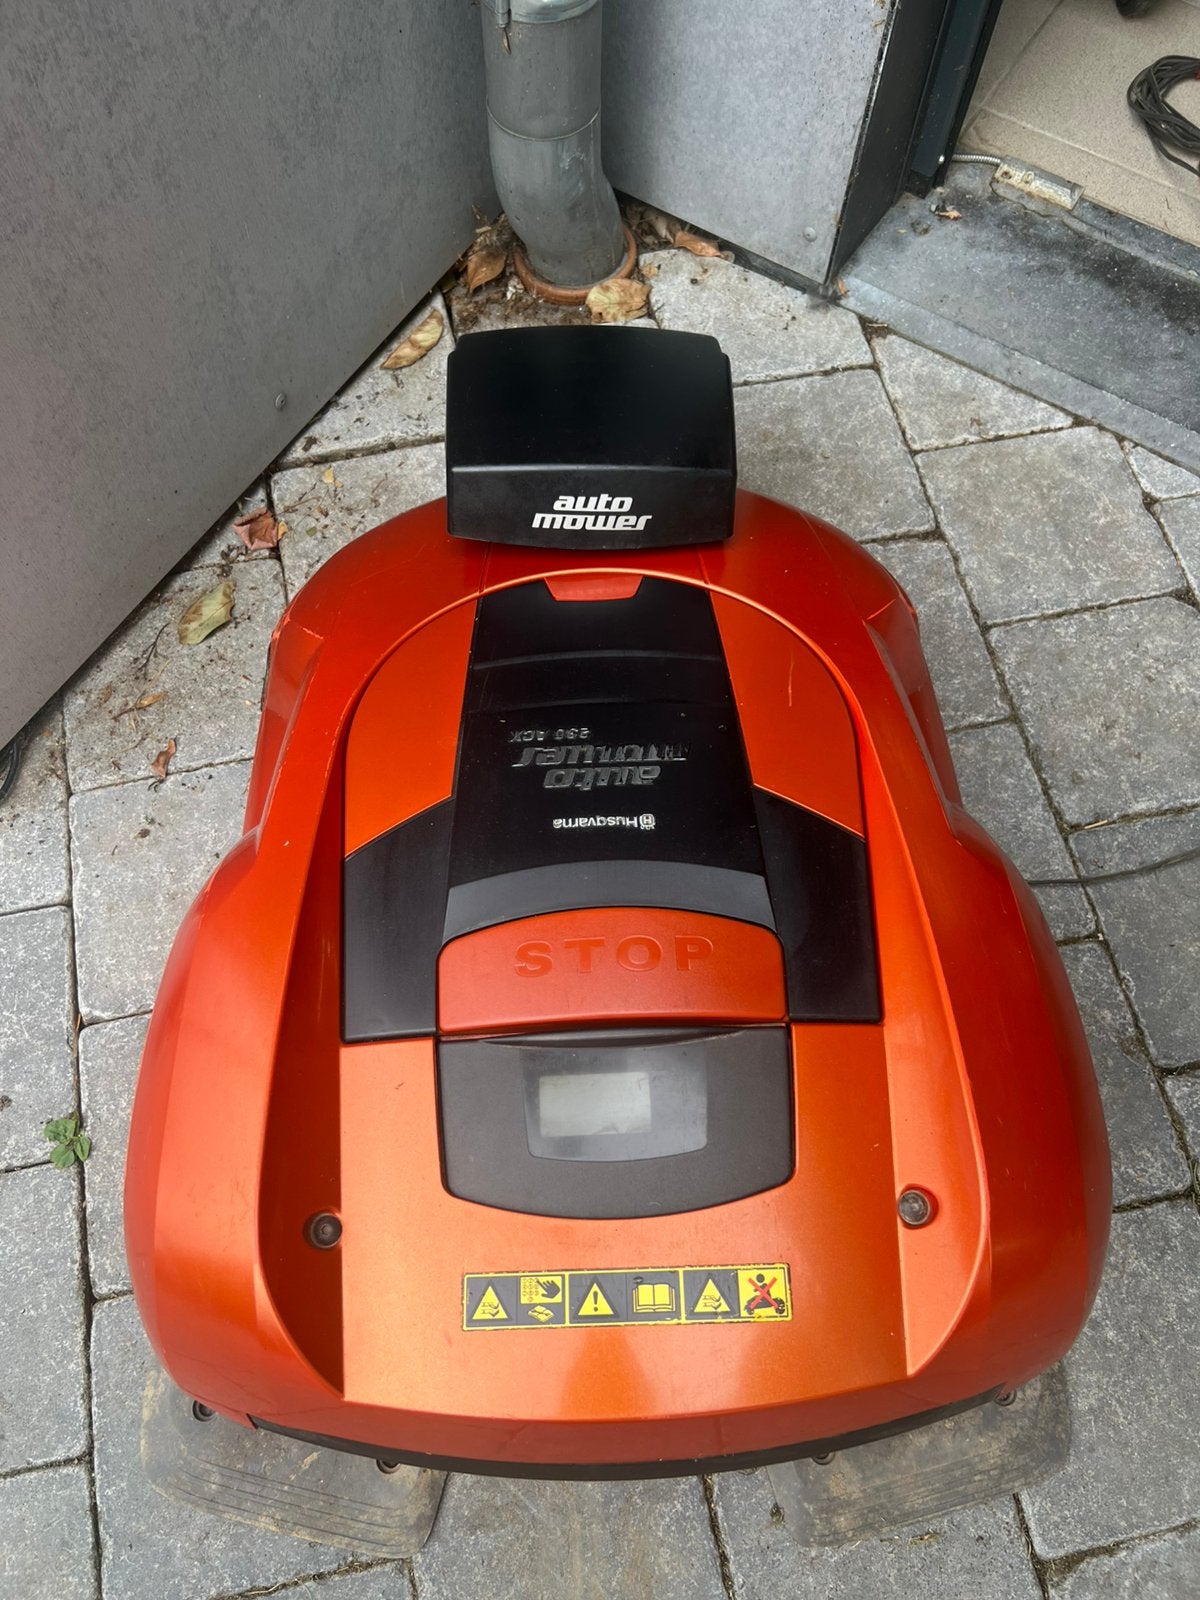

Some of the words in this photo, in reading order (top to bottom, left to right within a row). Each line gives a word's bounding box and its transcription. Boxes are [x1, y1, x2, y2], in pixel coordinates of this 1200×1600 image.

[553, 493, 633, 512] auto
[531, 513, 652, 531] mower
[543, 765, 661, 791] auto
[552, 814, 638, 829] Husqvarna
[514, 935, 714, 978] STOP
